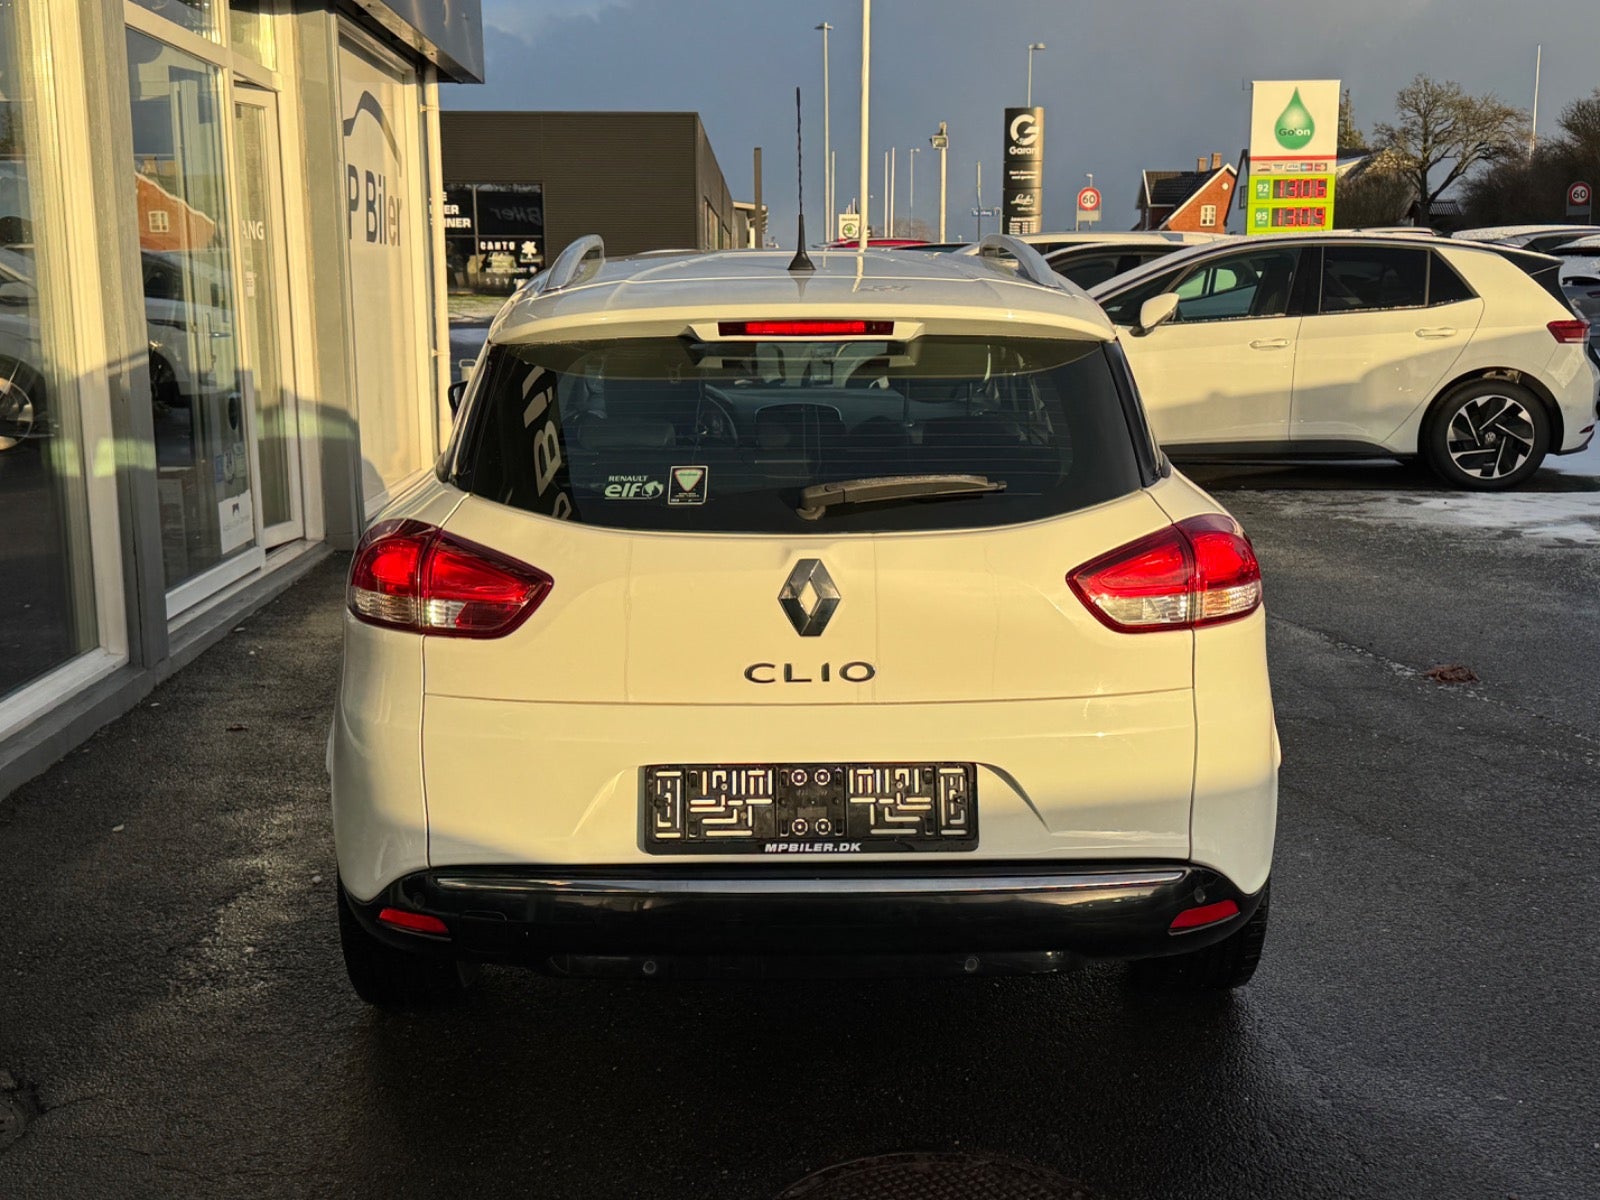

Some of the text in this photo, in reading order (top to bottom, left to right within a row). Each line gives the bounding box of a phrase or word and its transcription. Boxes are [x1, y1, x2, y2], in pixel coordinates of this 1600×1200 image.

[1257, 184, 1269, 192] 92
[1082, 194, 1096, 204] 60
[1573, 189, 1586, 199] 60
[365, 171, 402, 247] Biler
[1256, 212, 1267, 220] 95
[241, 221, 265, 240] ANG
[605, 482, 642, 497] elf
[744, 661, 876, 683] CLIO
[764, 842, 862, 853] MPBILER.DK
